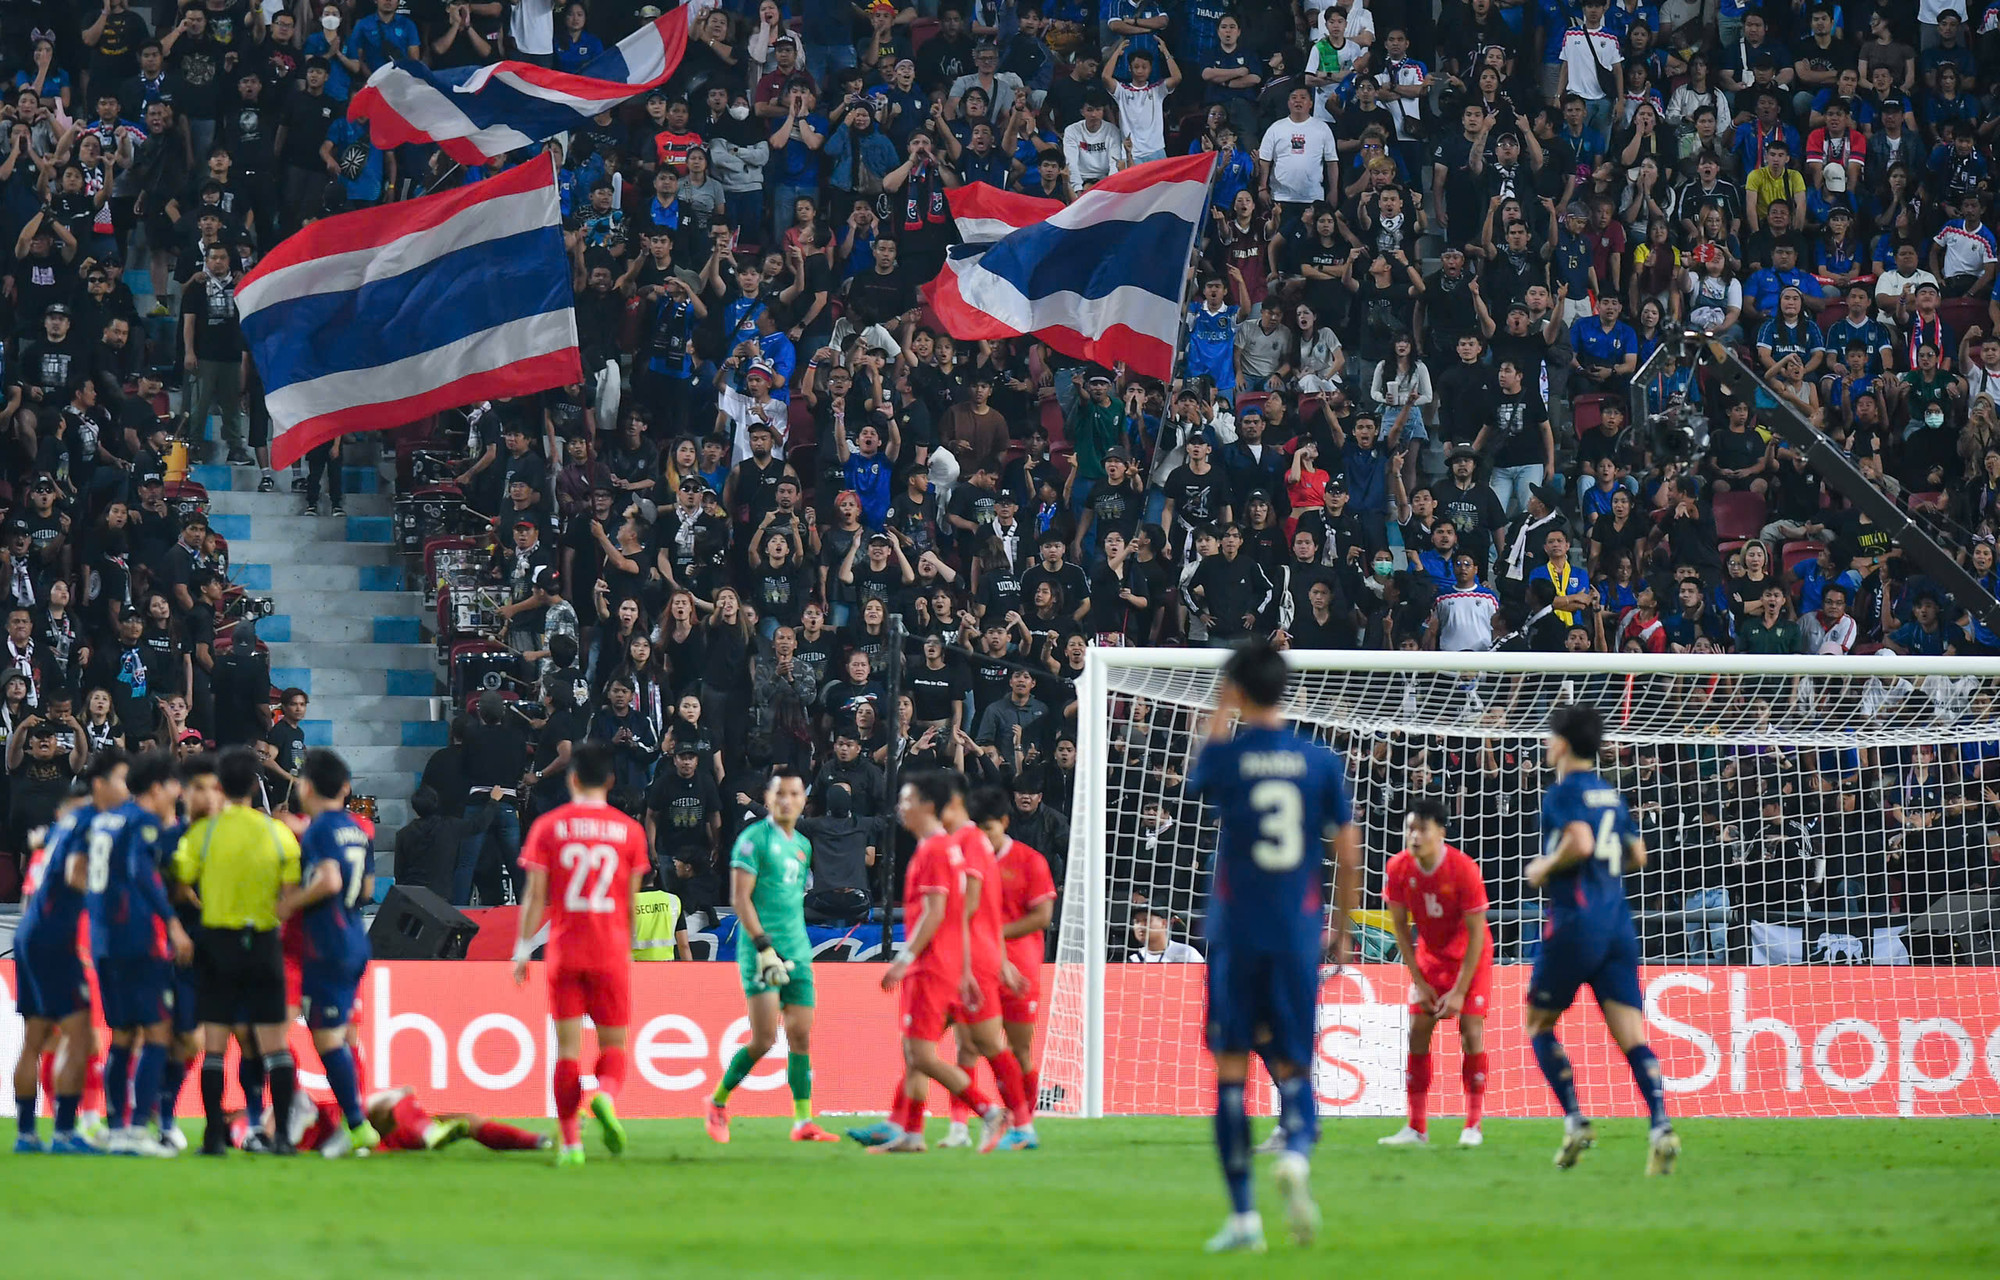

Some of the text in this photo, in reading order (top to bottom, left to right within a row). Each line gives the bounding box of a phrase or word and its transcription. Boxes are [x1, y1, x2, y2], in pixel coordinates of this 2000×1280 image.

[1087, 143, 1106, 152] DIESEL
[1568, 255, 1578, 269] 15
[996, 580, 1021, 592] ULTRAS
[1248, 779, 1304, 873] 3
[1594, 808, 1622, 878] 4
[88, 832, 114, 894] 8
[344, 846, 367, 908] 7
[560, 842, 619, 913] 22
[635, 903, 670, 916] SECURITY
